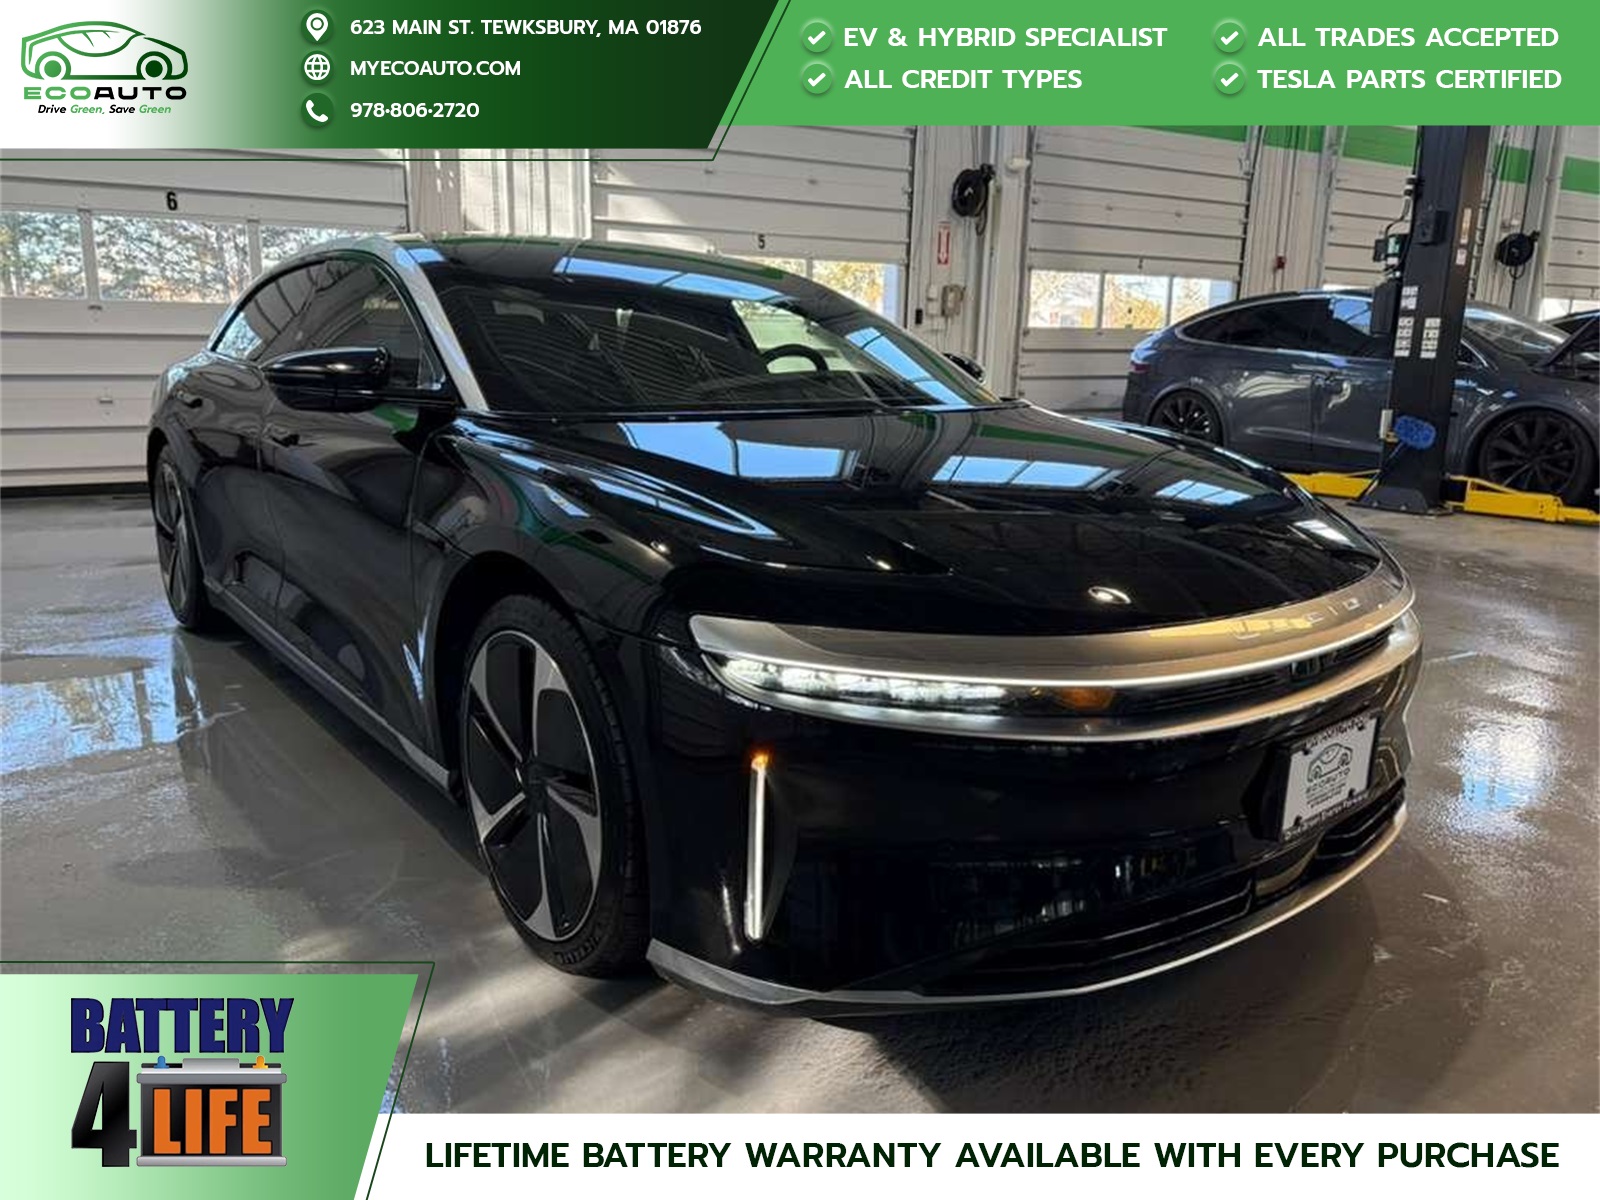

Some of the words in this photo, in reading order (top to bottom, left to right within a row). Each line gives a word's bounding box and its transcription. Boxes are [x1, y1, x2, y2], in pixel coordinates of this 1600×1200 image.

[165, 190, 179, 211] 6
[757, 233, 766, 250] 5
[1233, 597, 1361, 640] LCID
